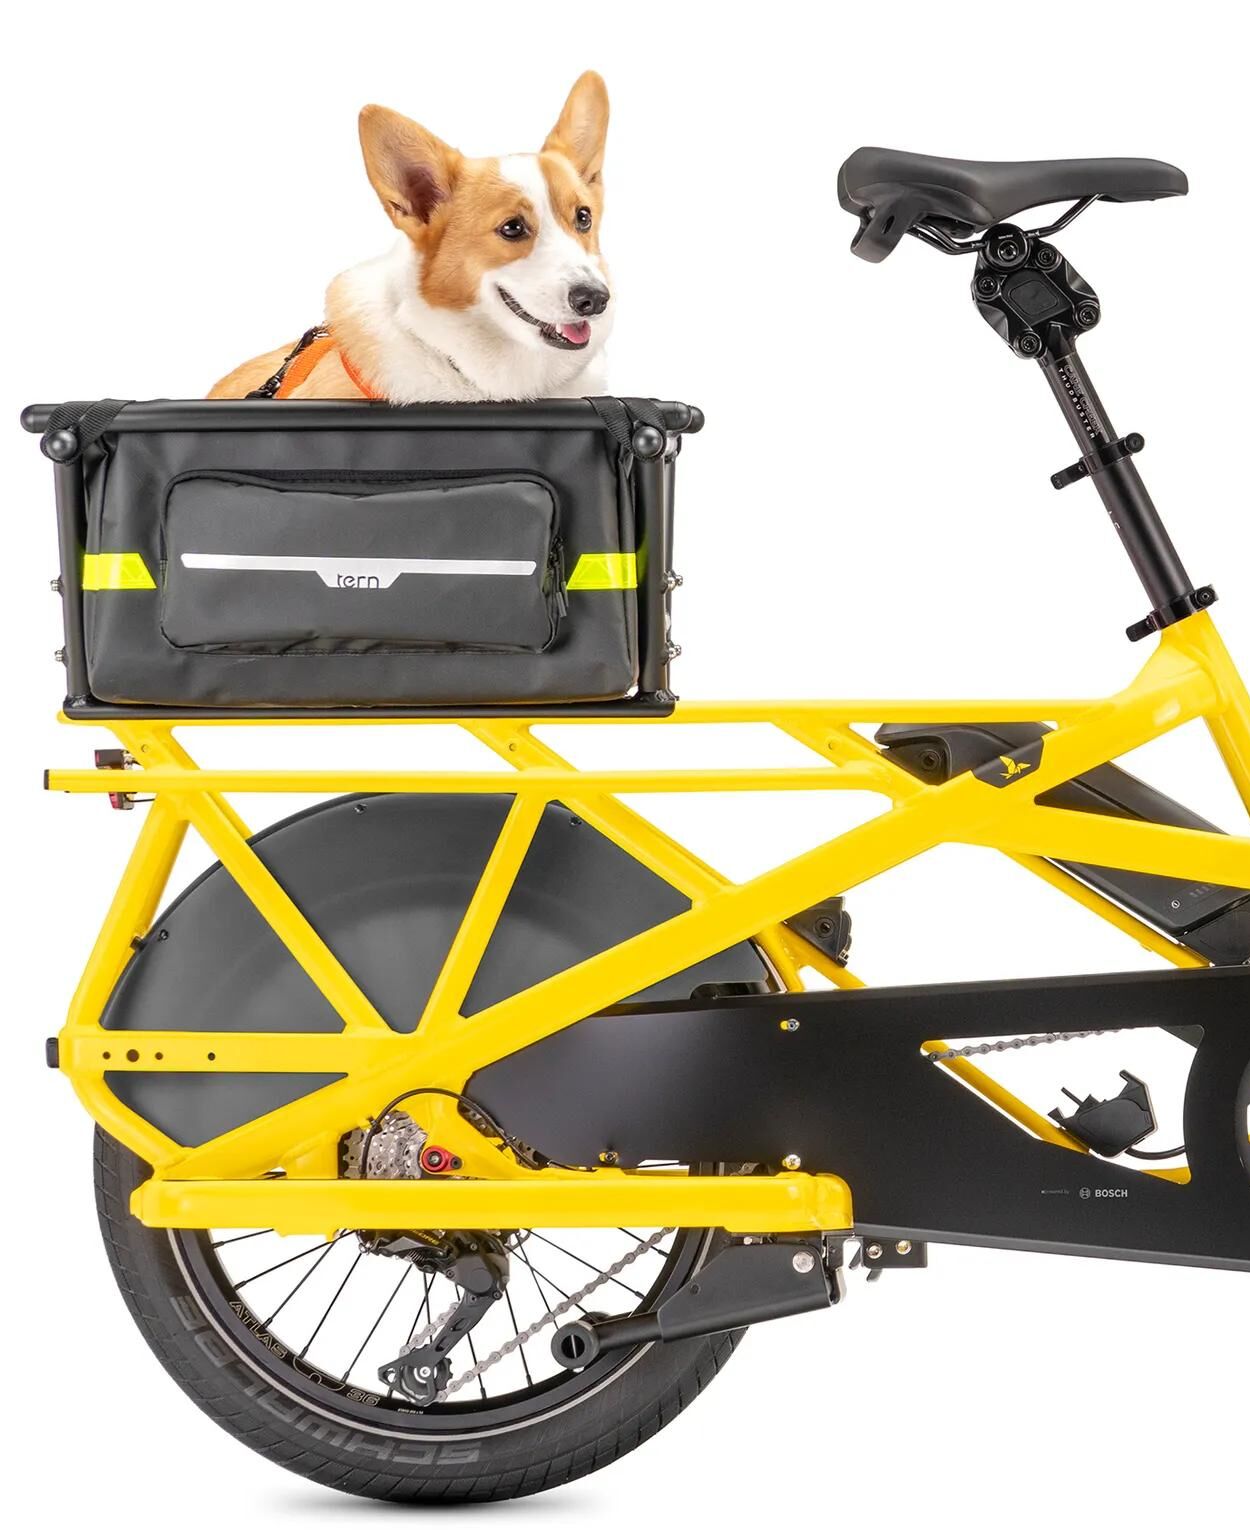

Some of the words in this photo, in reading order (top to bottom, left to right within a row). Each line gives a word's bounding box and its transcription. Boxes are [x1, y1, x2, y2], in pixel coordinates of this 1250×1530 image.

[1058, 367, 1095, 439] THUDBUSTER
[337, 573, 379, 589] tern
[1095, 1189, 1128, 1198] BOSCH
[171, 1296, 481, 1466] SCHWALBE
[229, 1300, 288, 1360] ATLAS
[347, 1388, 381, 1407] 36
